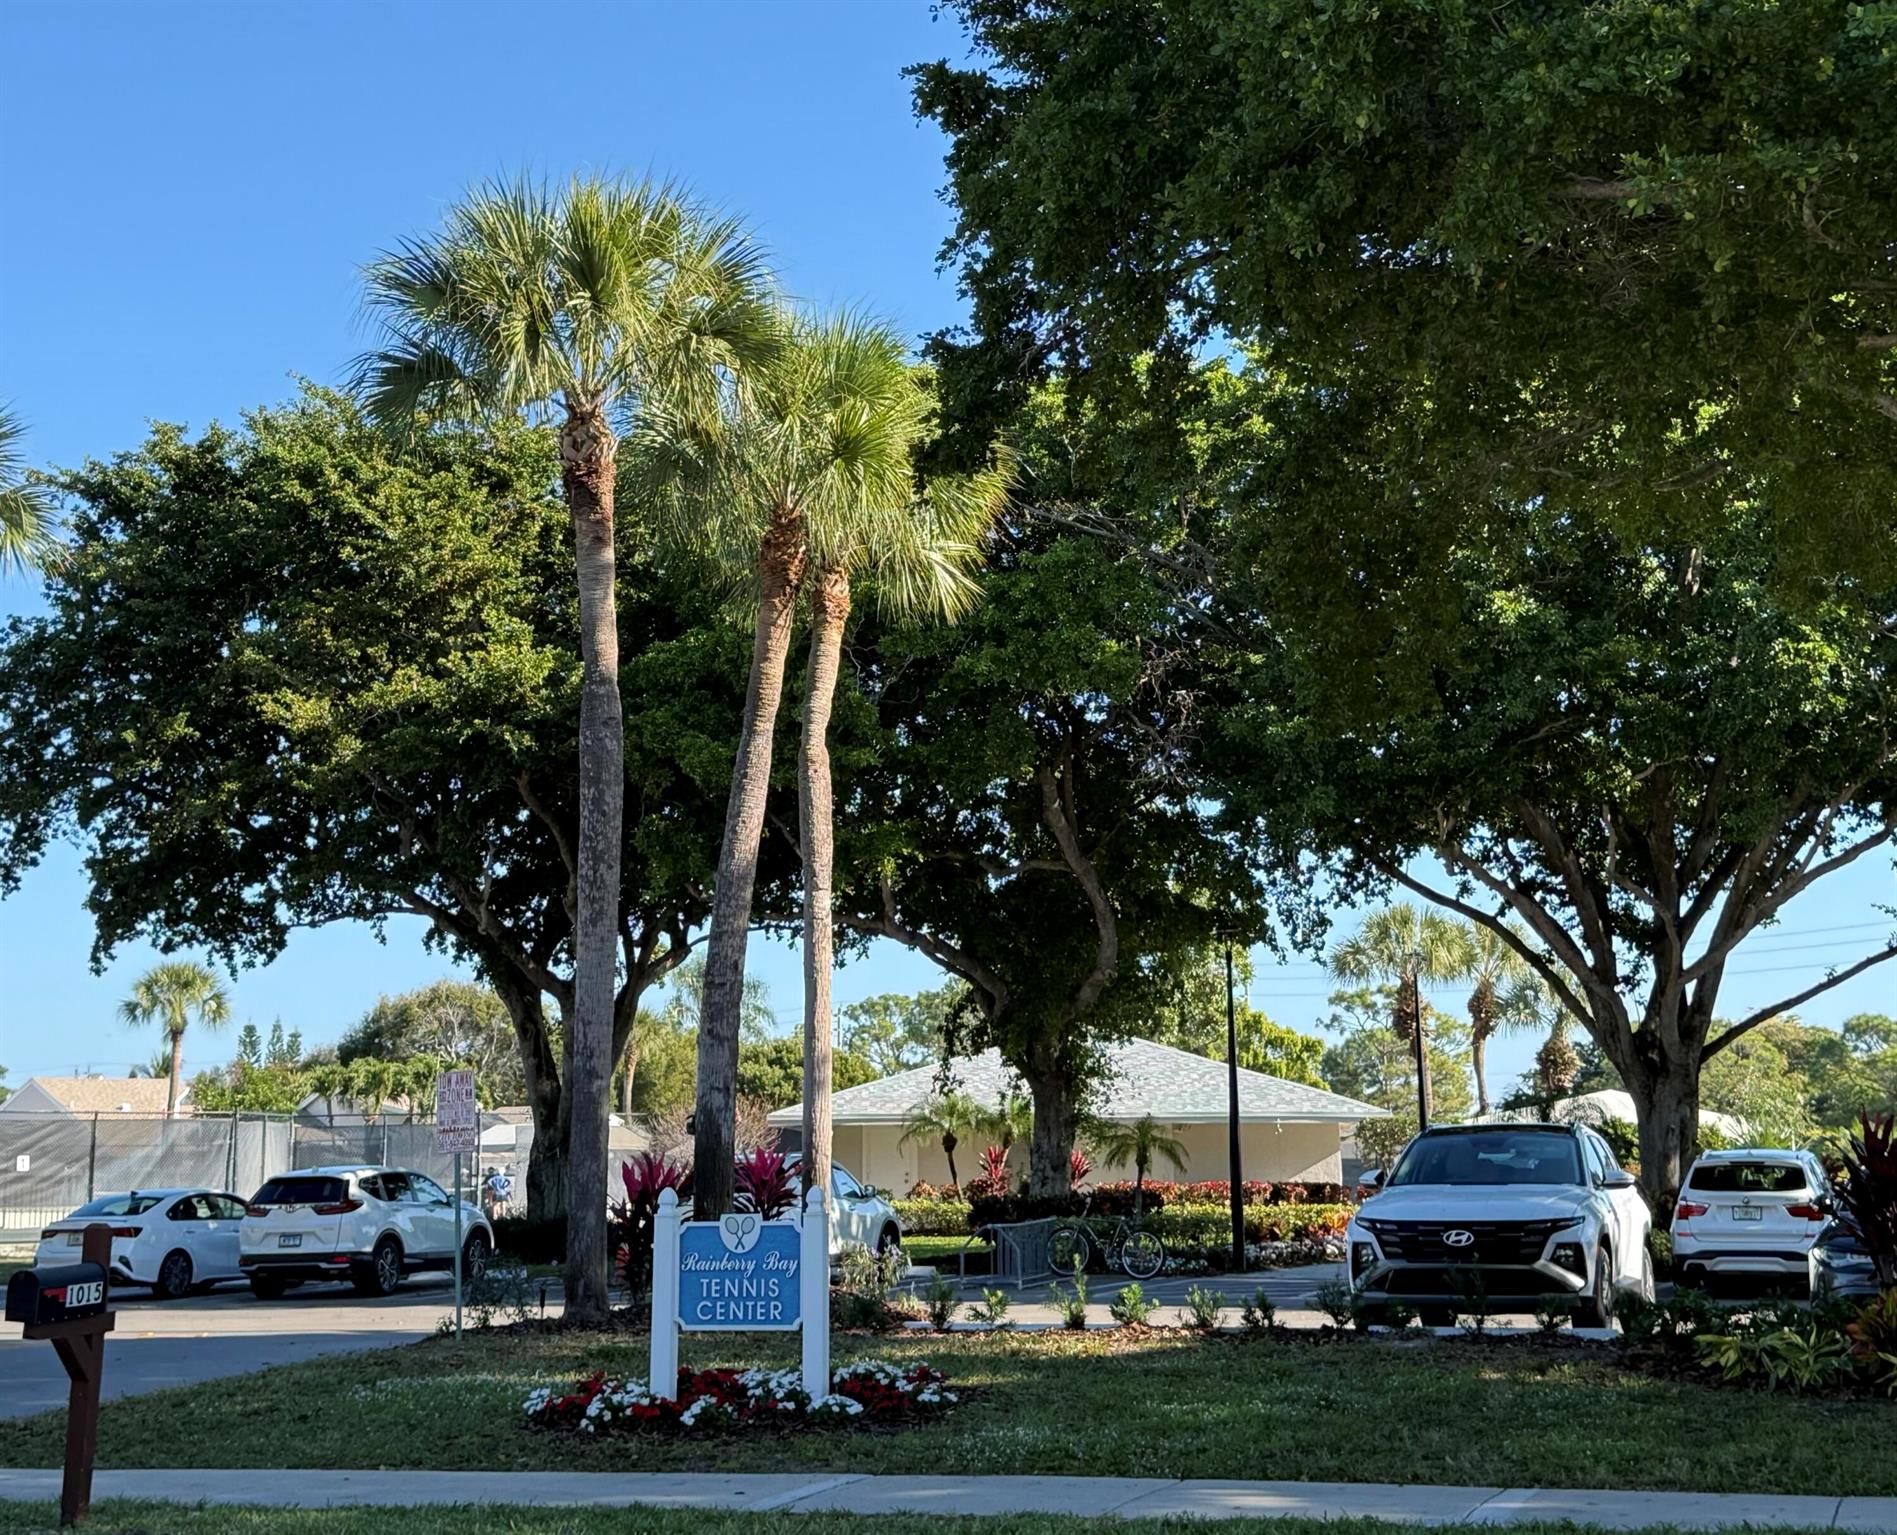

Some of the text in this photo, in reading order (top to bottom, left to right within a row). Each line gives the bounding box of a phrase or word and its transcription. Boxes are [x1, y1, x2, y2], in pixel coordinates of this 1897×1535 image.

[439, 1072, 472, 1090] TOW AWAY
[447, 1088, 465, 1103] ZONE
[681, 1250, 798, 1278] Rainberry Bay
[69, 1284, 102, 1305] 1015
[700, 1278, 780, 1298] TENNIS
[697, 1301, 782, 1320] CENTER
